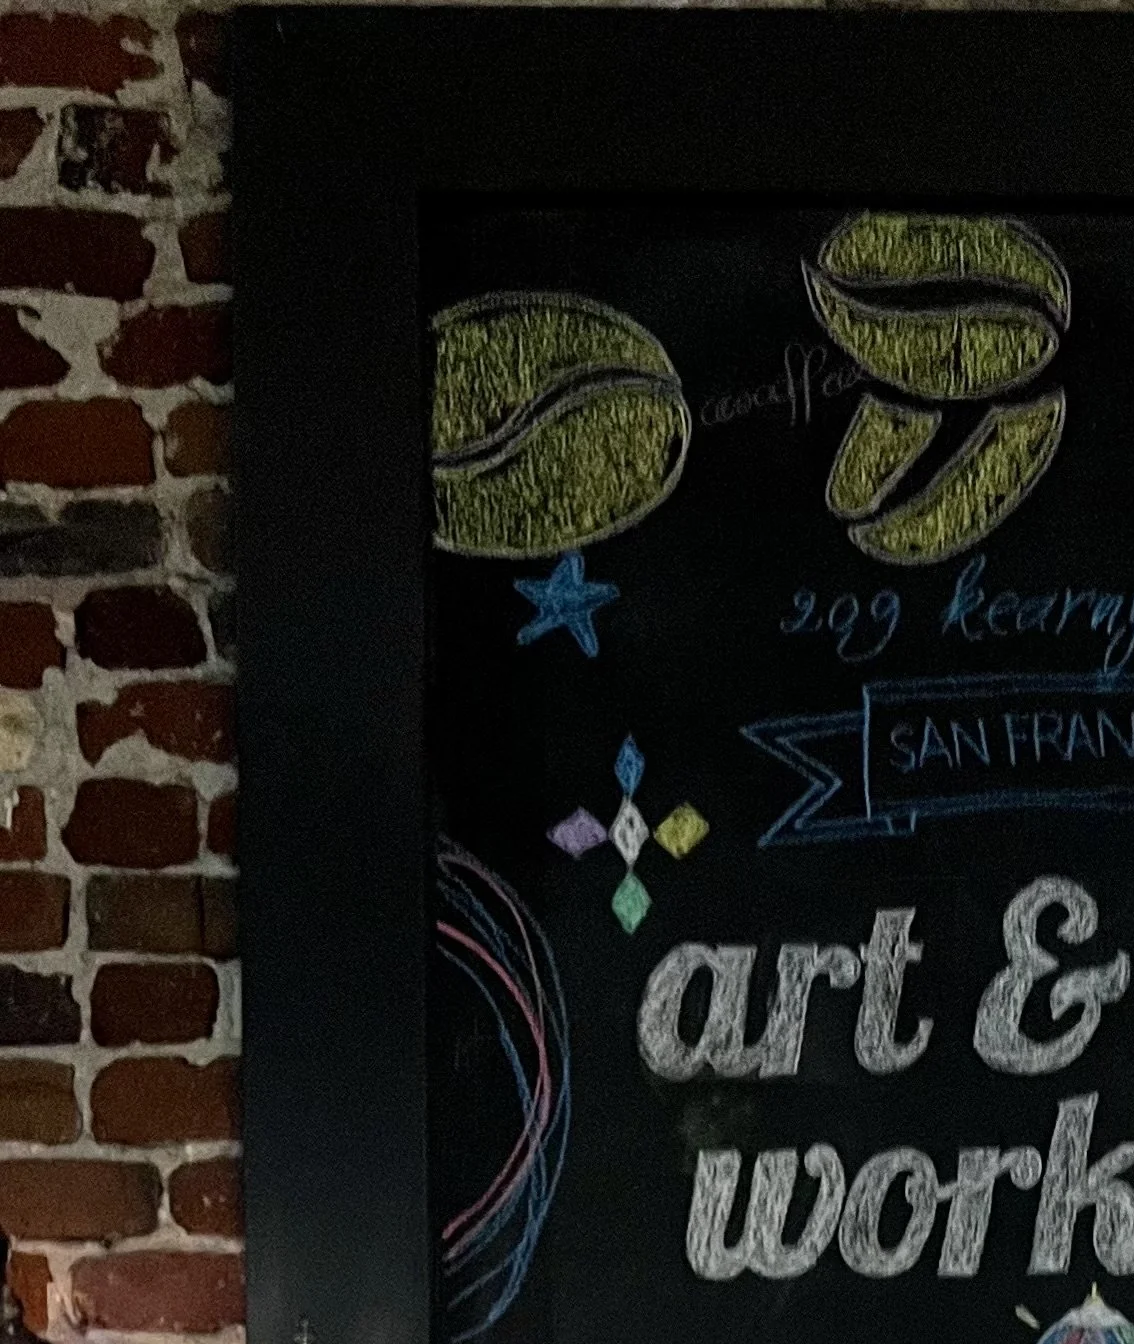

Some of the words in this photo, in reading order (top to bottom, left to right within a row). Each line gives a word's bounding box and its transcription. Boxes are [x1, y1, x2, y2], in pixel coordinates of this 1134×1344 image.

[890, 715, 991, 773] SAN
[637, 906, 934, 1082] art
[973, 875, 1131, 1076] &
